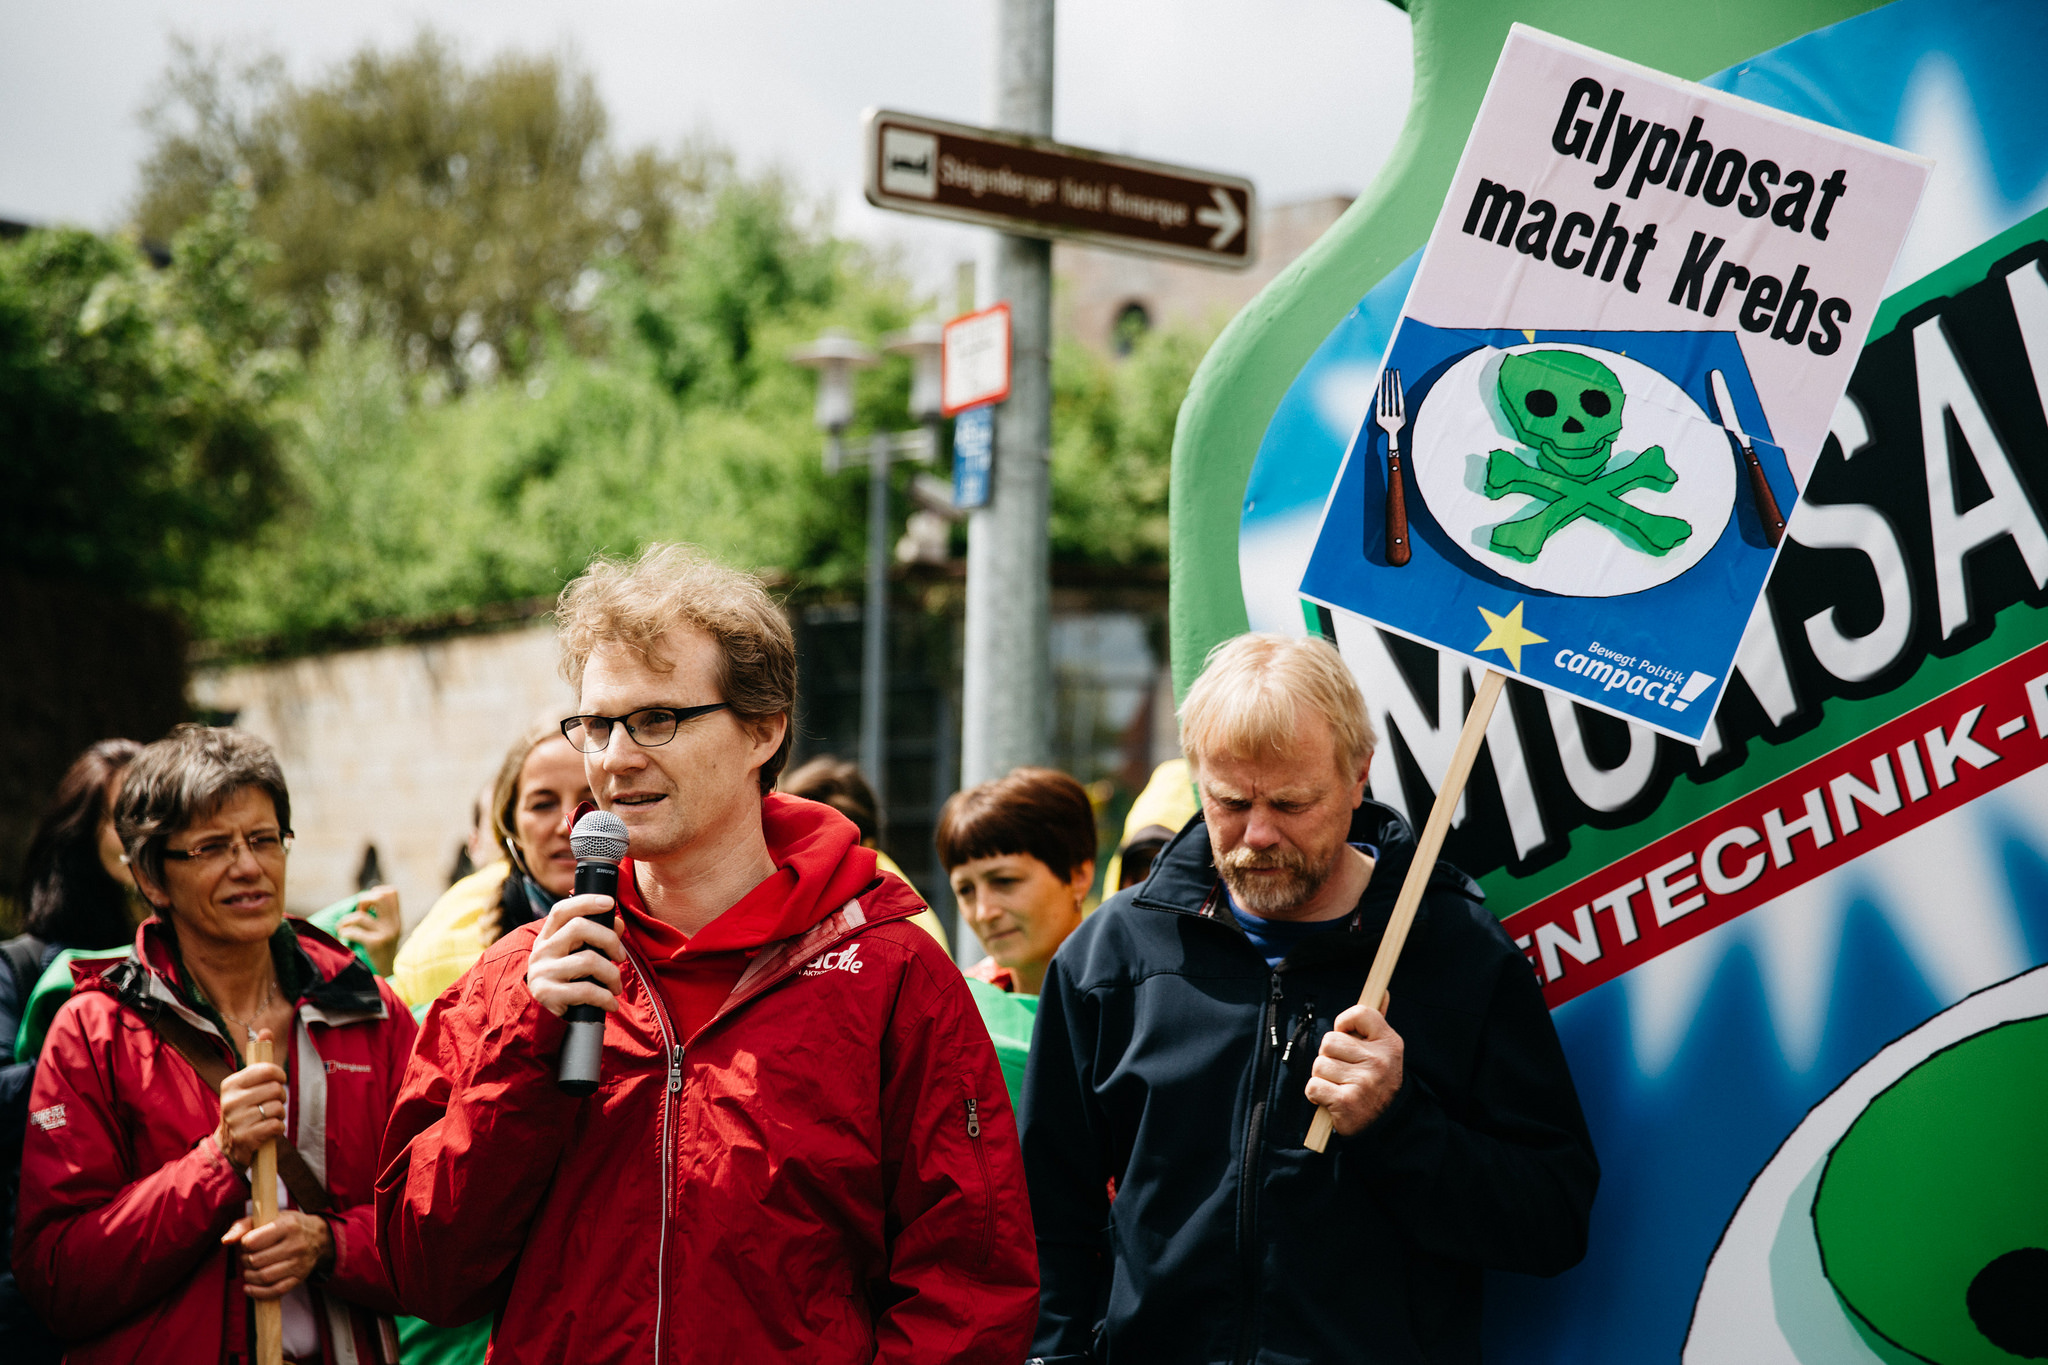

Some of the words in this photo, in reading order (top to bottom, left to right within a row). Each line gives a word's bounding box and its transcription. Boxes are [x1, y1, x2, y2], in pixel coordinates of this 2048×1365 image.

[1552, 77, 1847, 242] Glyphosat
[1462, 177, 1658, 294] macht
[1668, 231, 1852, 357] Krebs
[1588, 641, 1638, 668] Bewegt
[1638, 659, 1686, 685] Politik
